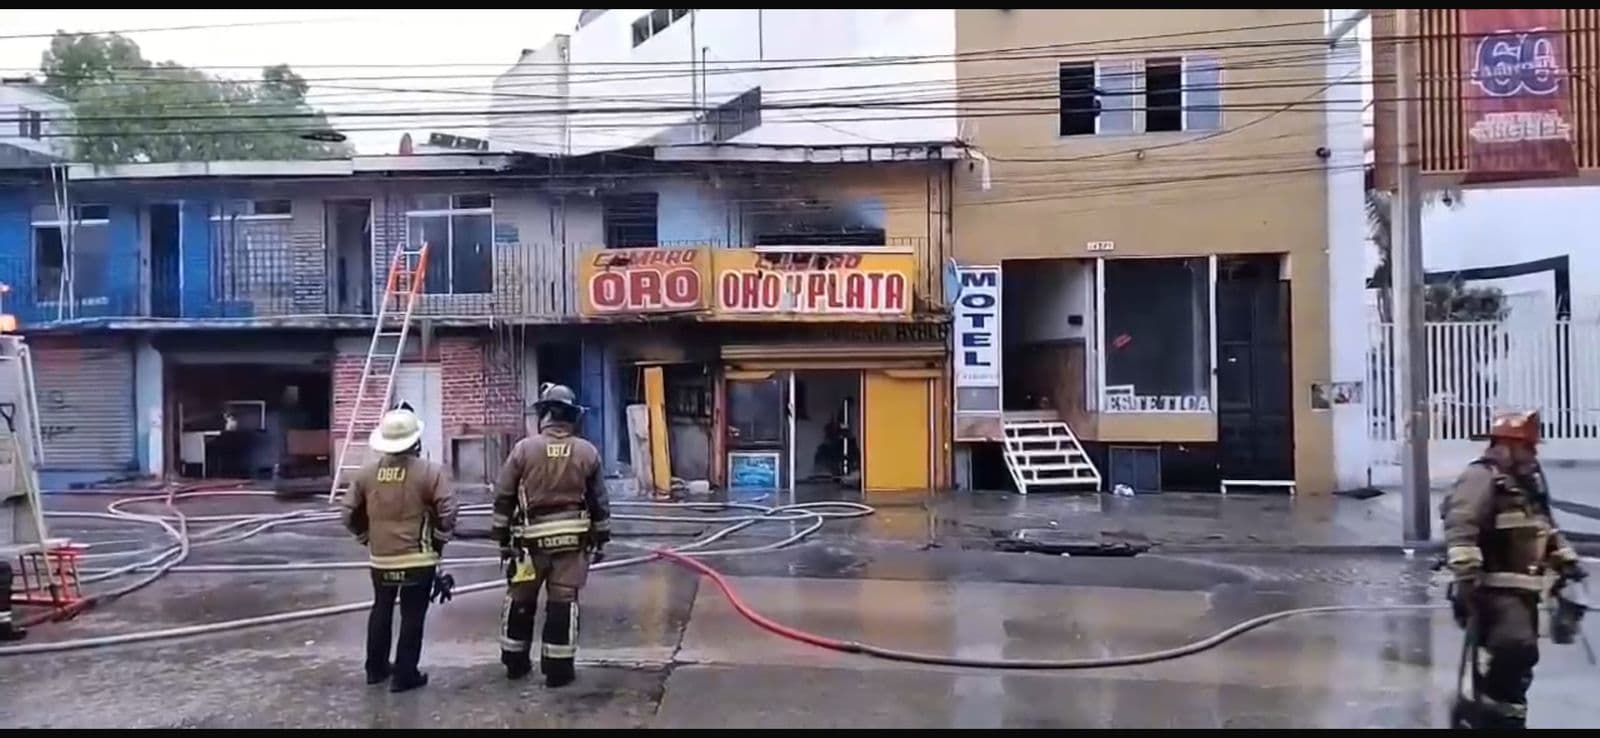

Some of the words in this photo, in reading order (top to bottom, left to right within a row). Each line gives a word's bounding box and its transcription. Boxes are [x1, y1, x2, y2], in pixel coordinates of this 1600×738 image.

[593, 249, 697, 268] CMPRO
[590, 268, 699, 309] ORO
[720, 271, 782, 310] ORO
[806, 272, 905, 311] PLATA
[960, 271, 997, 367] MOTEL
